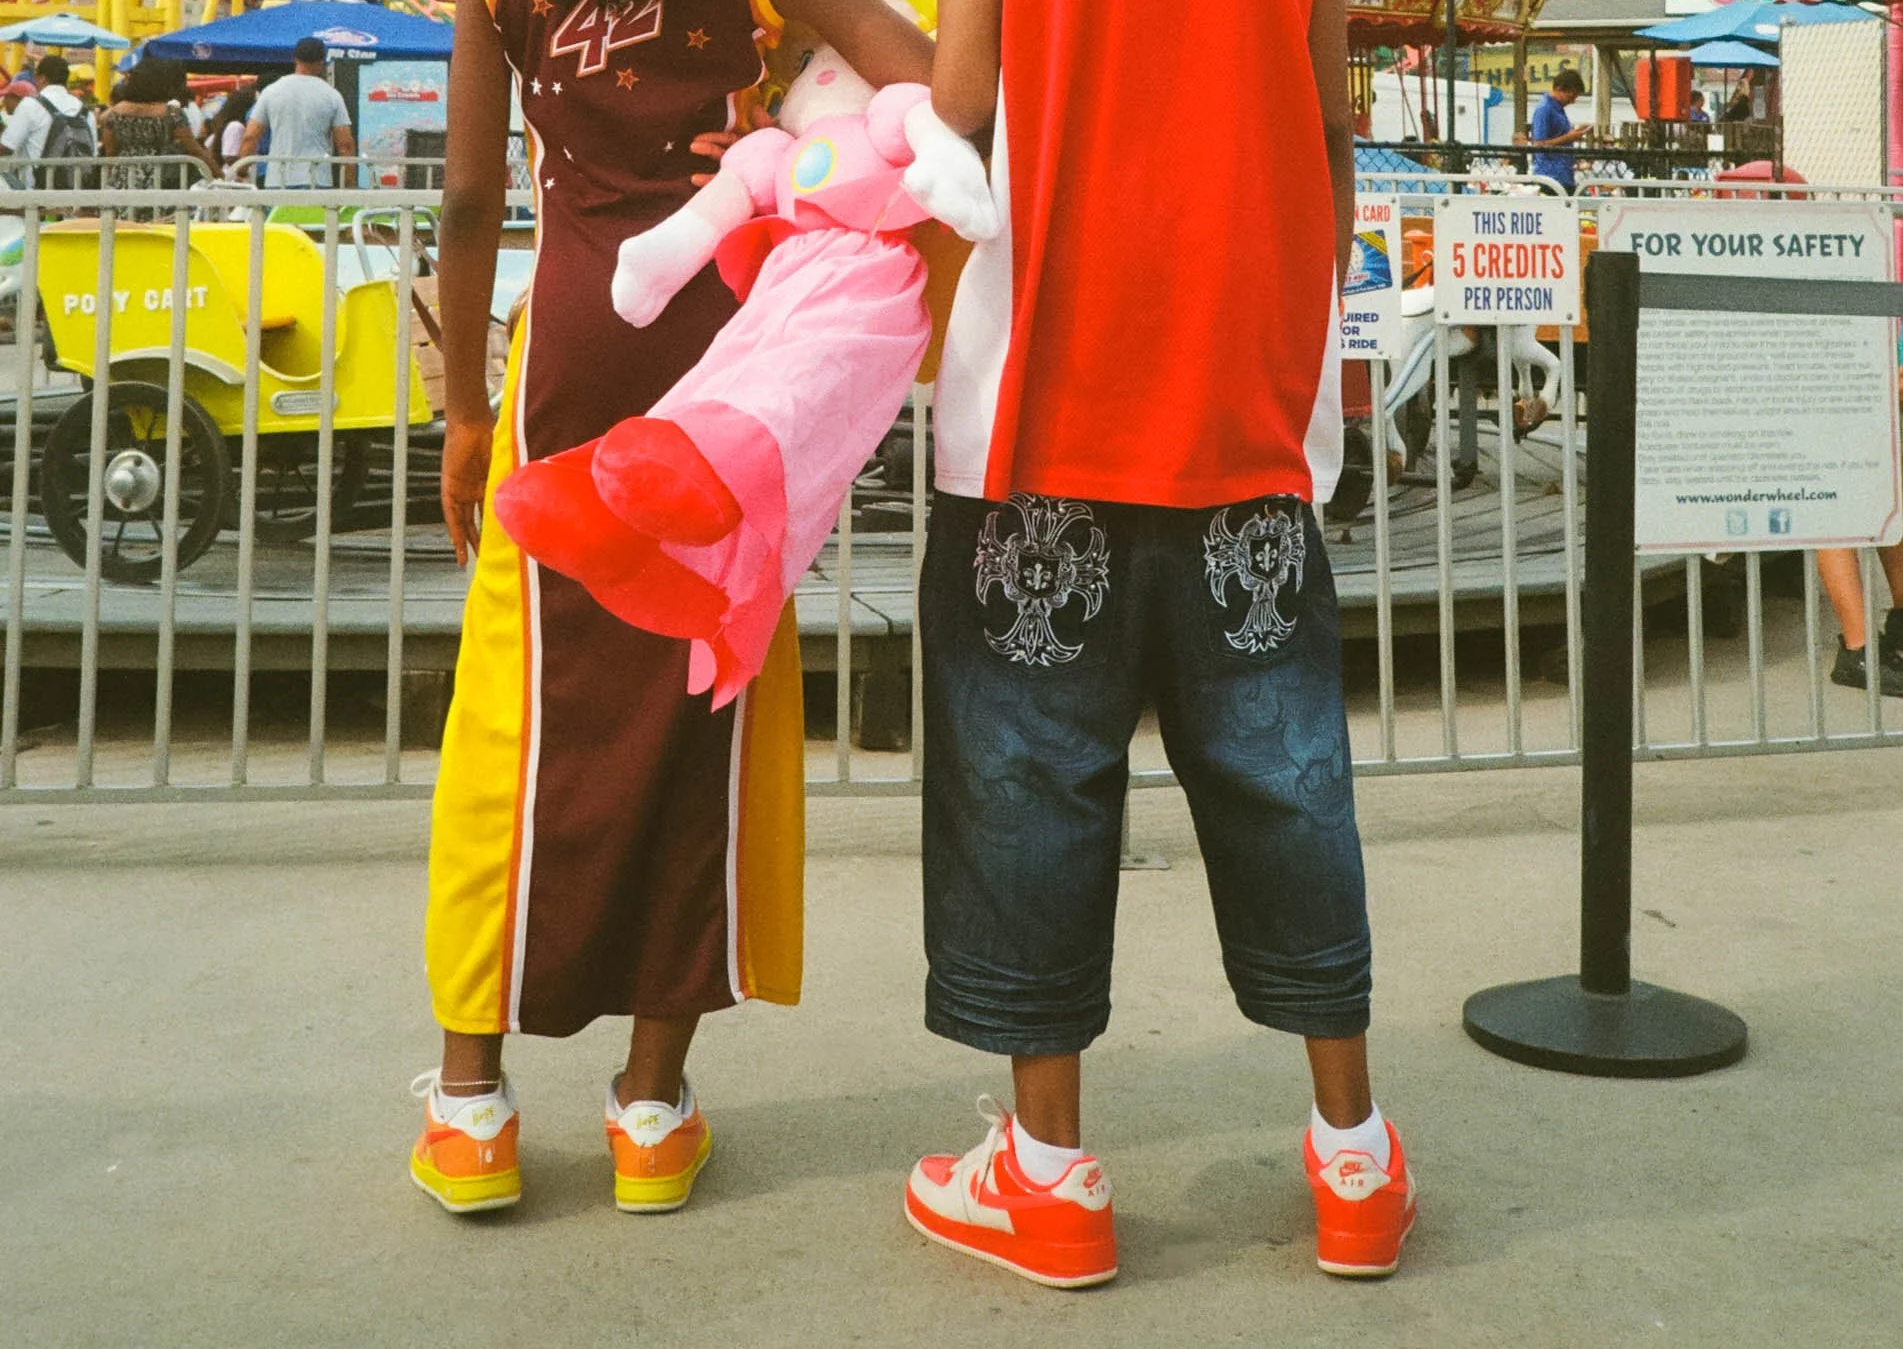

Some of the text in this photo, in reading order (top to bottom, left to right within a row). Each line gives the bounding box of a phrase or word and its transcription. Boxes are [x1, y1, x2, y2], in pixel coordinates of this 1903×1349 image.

[1362, 204, 1391, 222] CARD
[1472, 212, 1543, 235] THIS RIDE
[1631, 232, 1865, 258] FOR YOUR SAFETY
[1452, 243, 1565, 280] 5 CREDITS
[64, 291, 130, 316] POY
[1464, 287, 1552, 311] PER PERSON
[1342, 325, 1360, 336] OR
[1348, 339, 1377, 349] RIDE
[1675, 487, 1838, 504] www.wonderwheel.com
